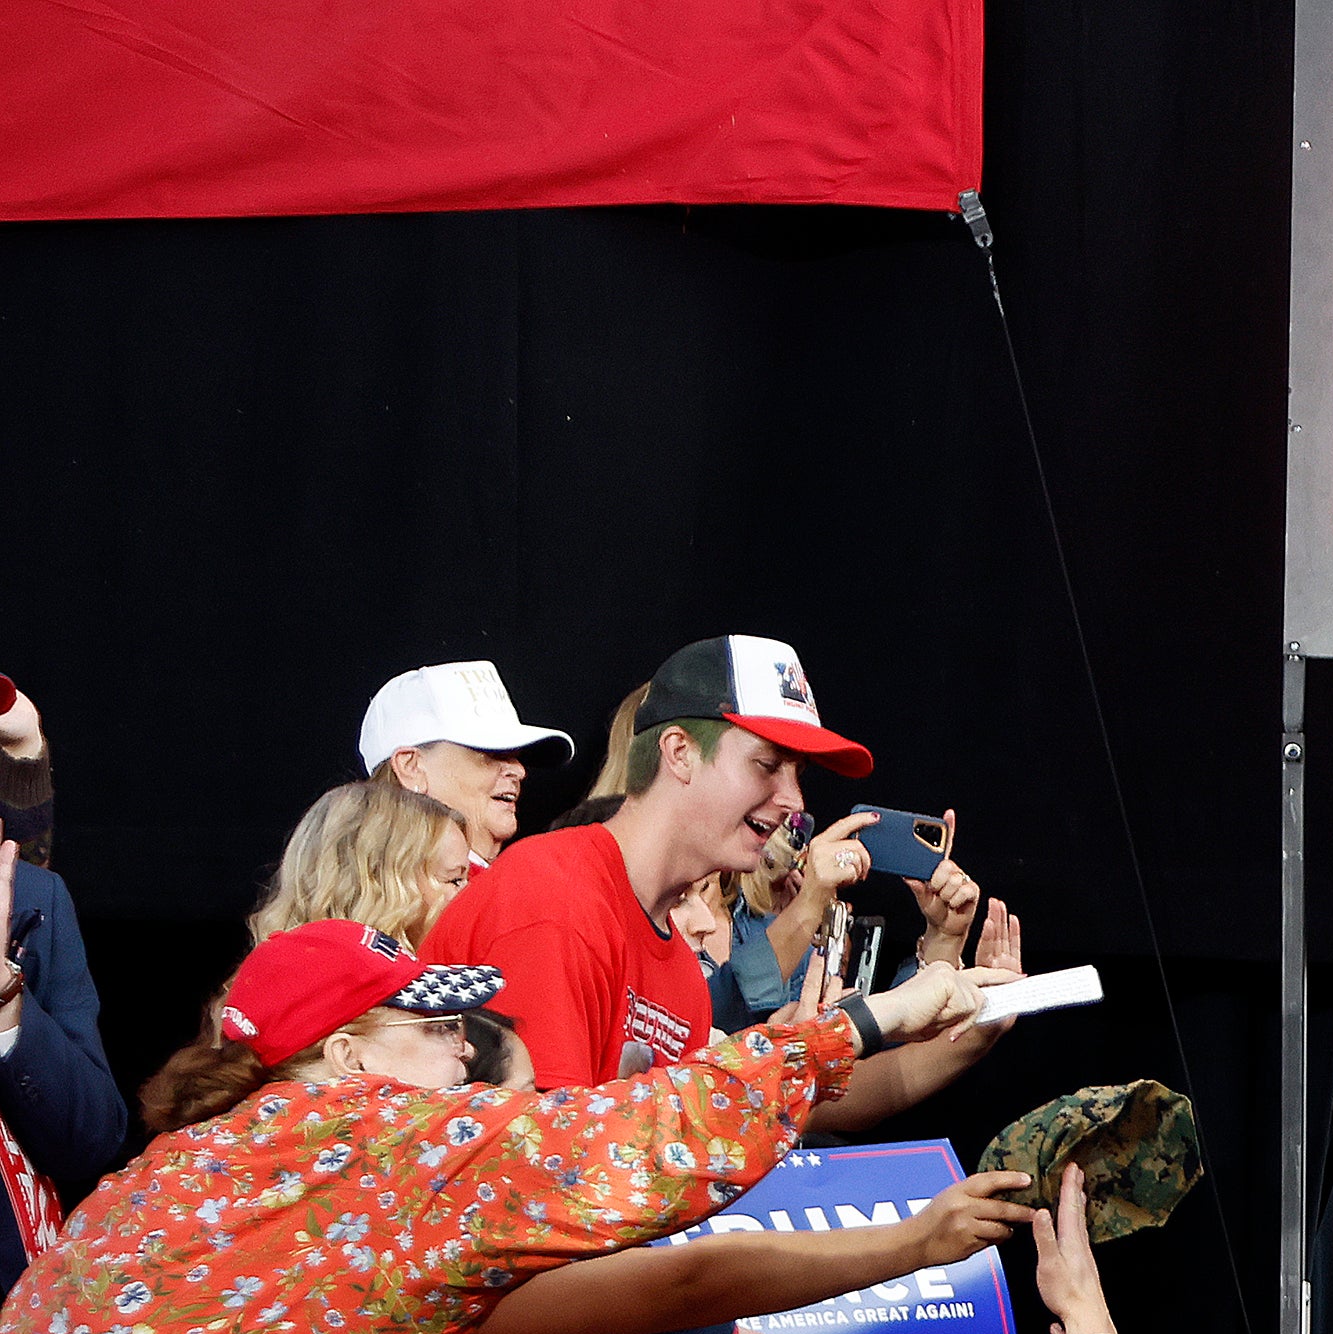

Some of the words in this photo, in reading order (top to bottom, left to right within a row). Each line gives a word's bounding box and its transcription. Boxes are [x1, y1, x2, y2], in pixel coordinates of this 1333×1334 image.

[736, 1316, 763, 1331] KE
[768, 1309, 850, 1329] AMERICA
[853, 1306, 910, 1324] GREAT
[915, 1302, 975, 1319] AGAIN!
